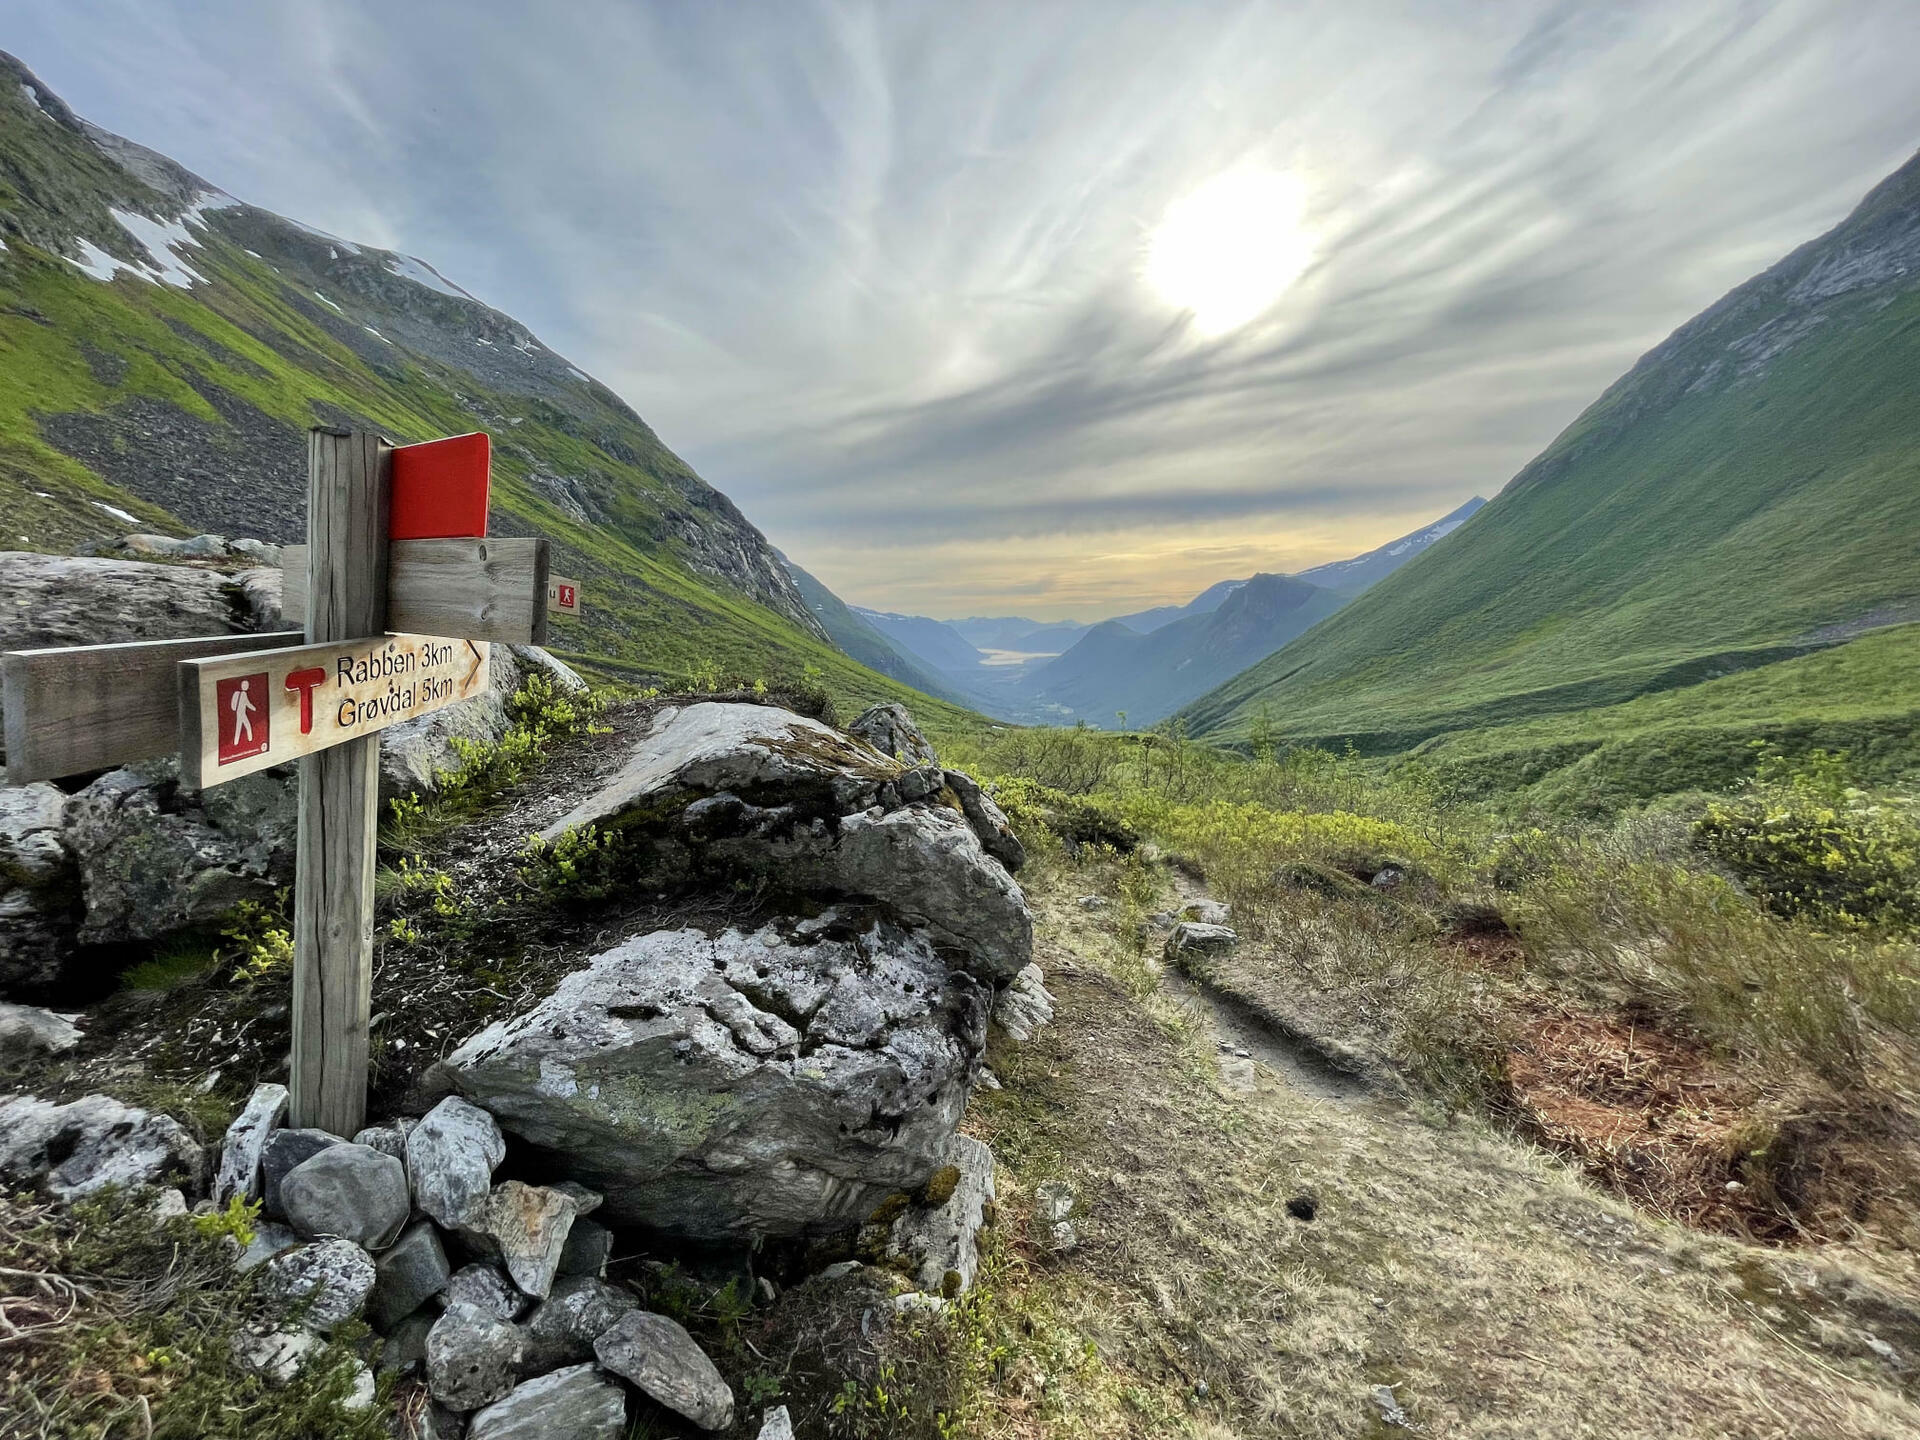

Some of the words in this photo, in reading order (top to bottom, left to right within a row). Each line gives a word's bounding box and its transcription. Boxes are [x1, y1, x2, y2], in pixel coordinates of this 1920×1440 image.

[337, 650, 415, 688] Rabben
[421, 642, 453, 668] 3km
[337, 682, 416, 727] Grøvdal
[422, 676, 453, 703] 5km
